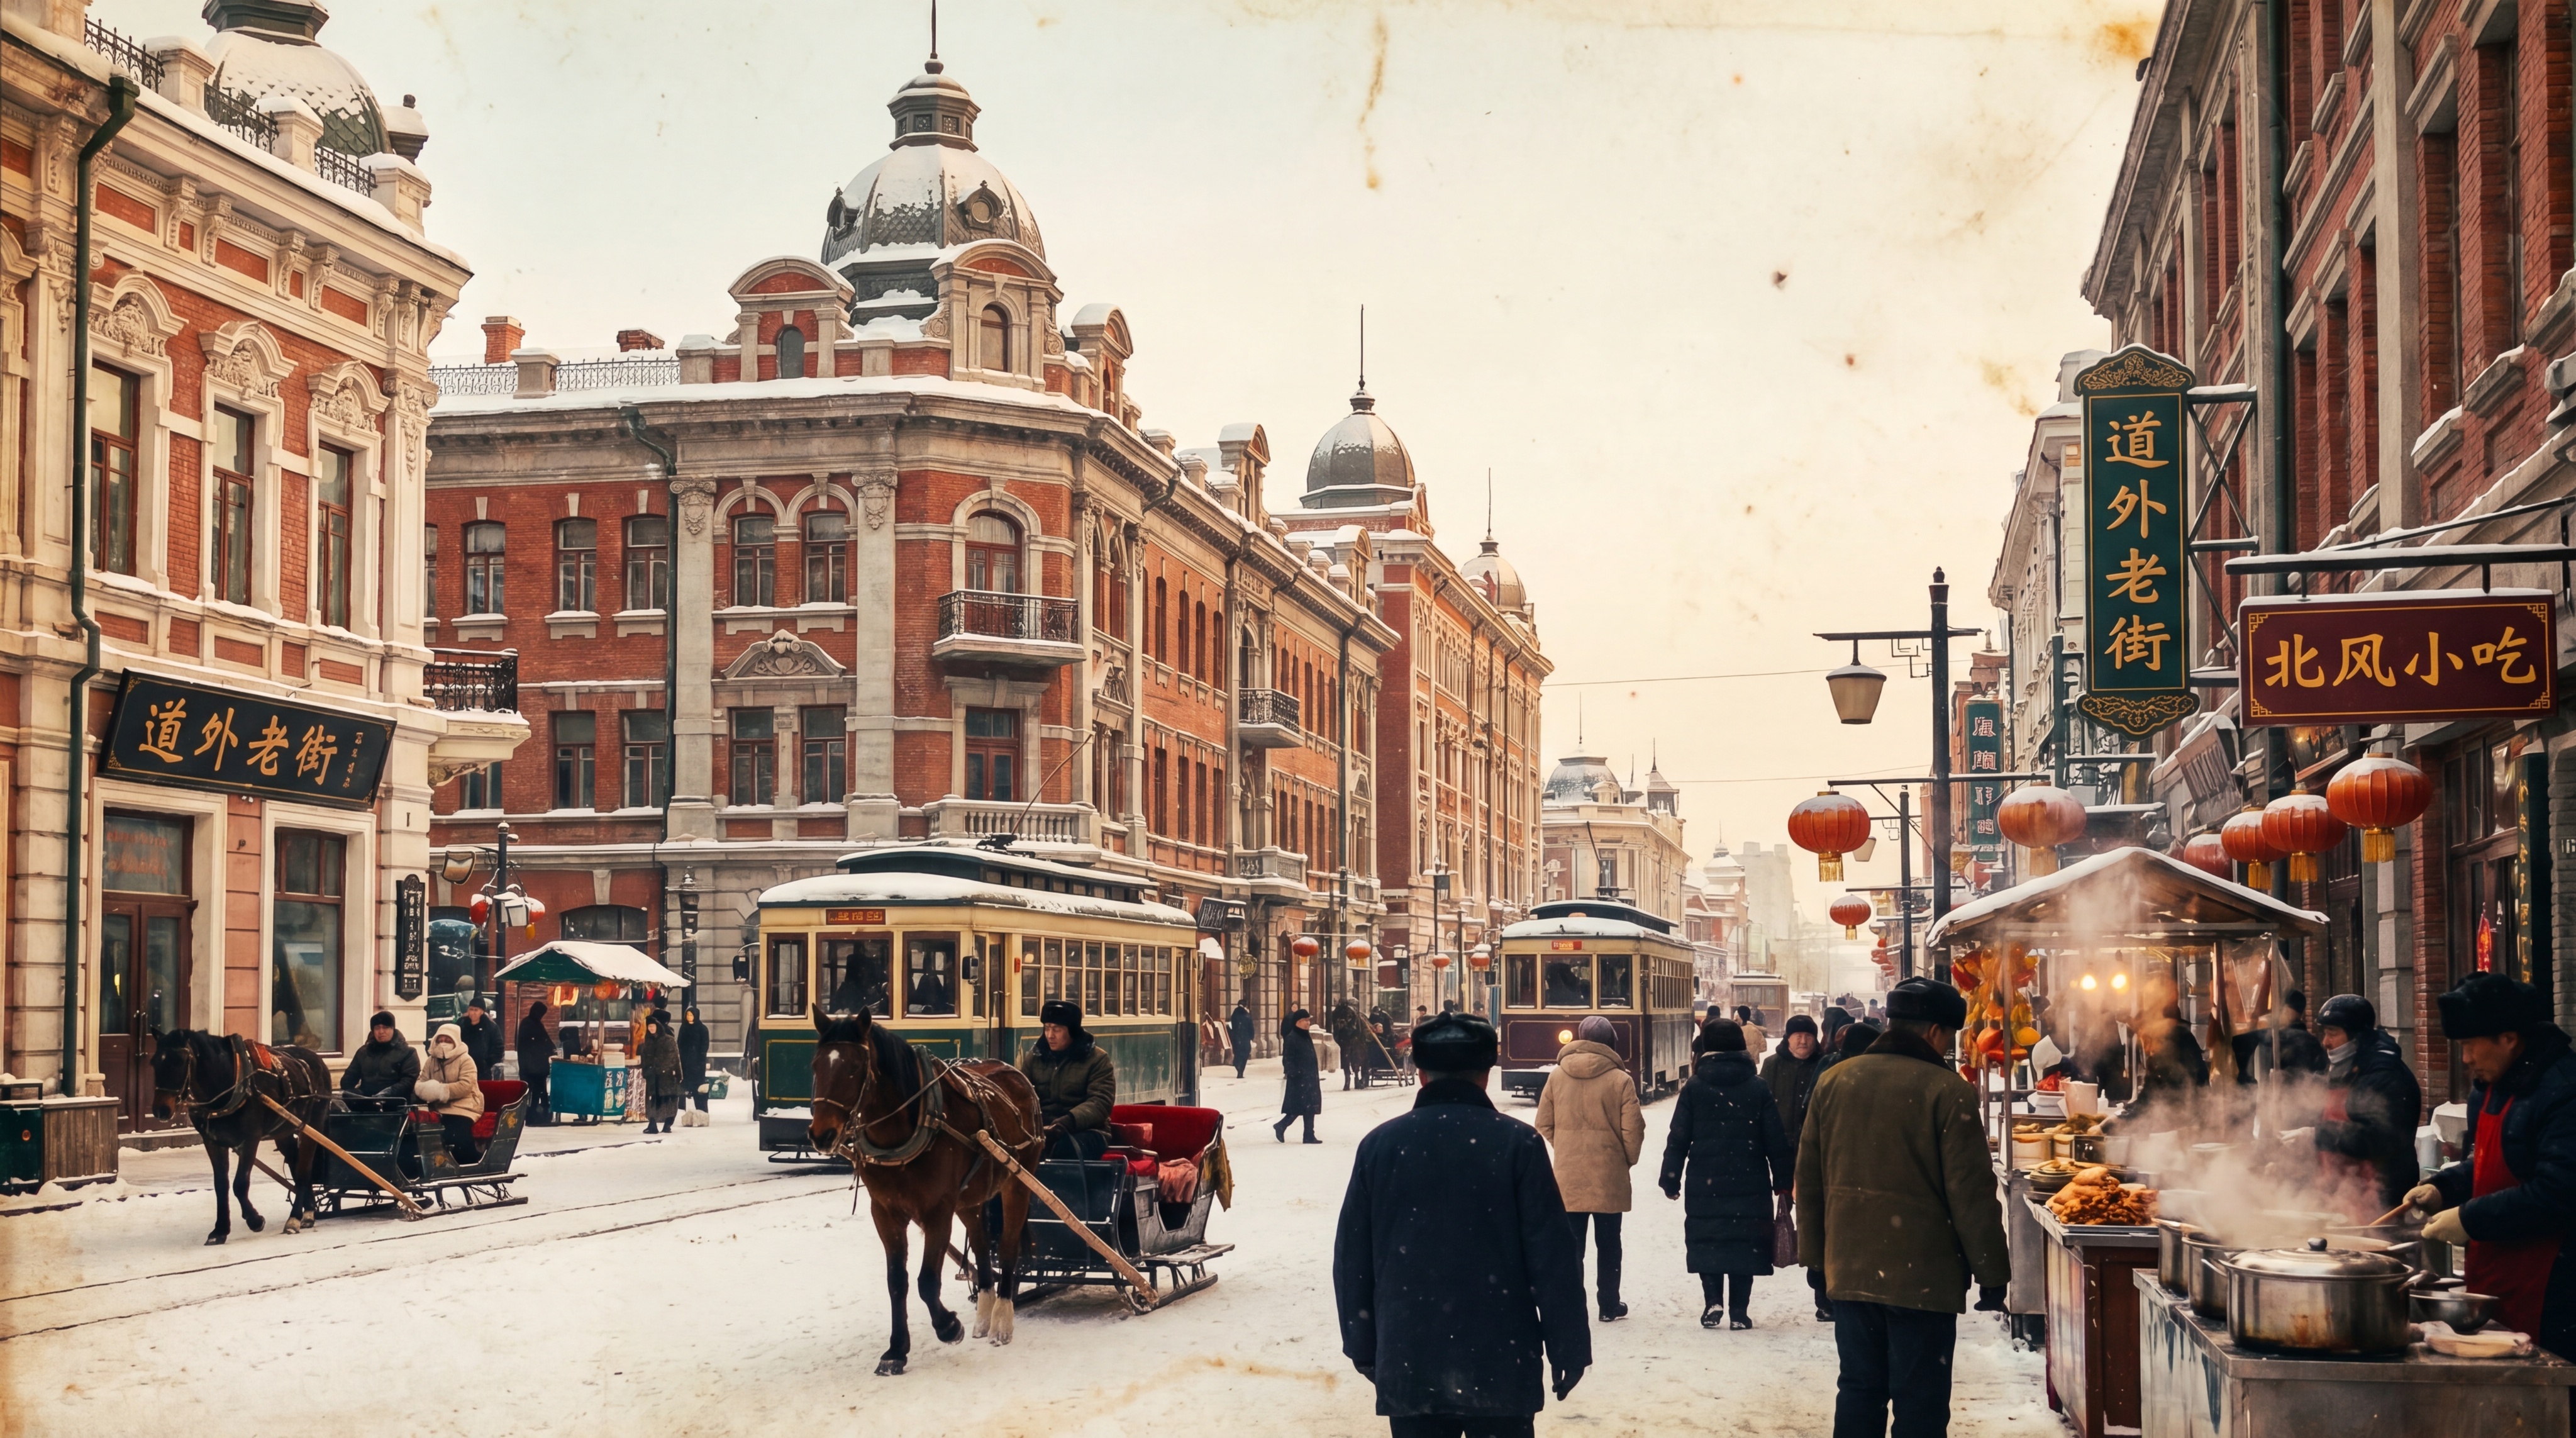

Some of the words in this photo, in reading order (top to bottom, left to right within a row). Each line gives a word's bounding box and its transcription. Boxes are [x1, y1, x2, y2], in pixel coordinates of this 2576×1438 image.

[2105, 410, 2170, 671] 道外老街
[2264, 626, 2537, 688] 北风小吃
[138, 698, 338, 785] 道外老街
